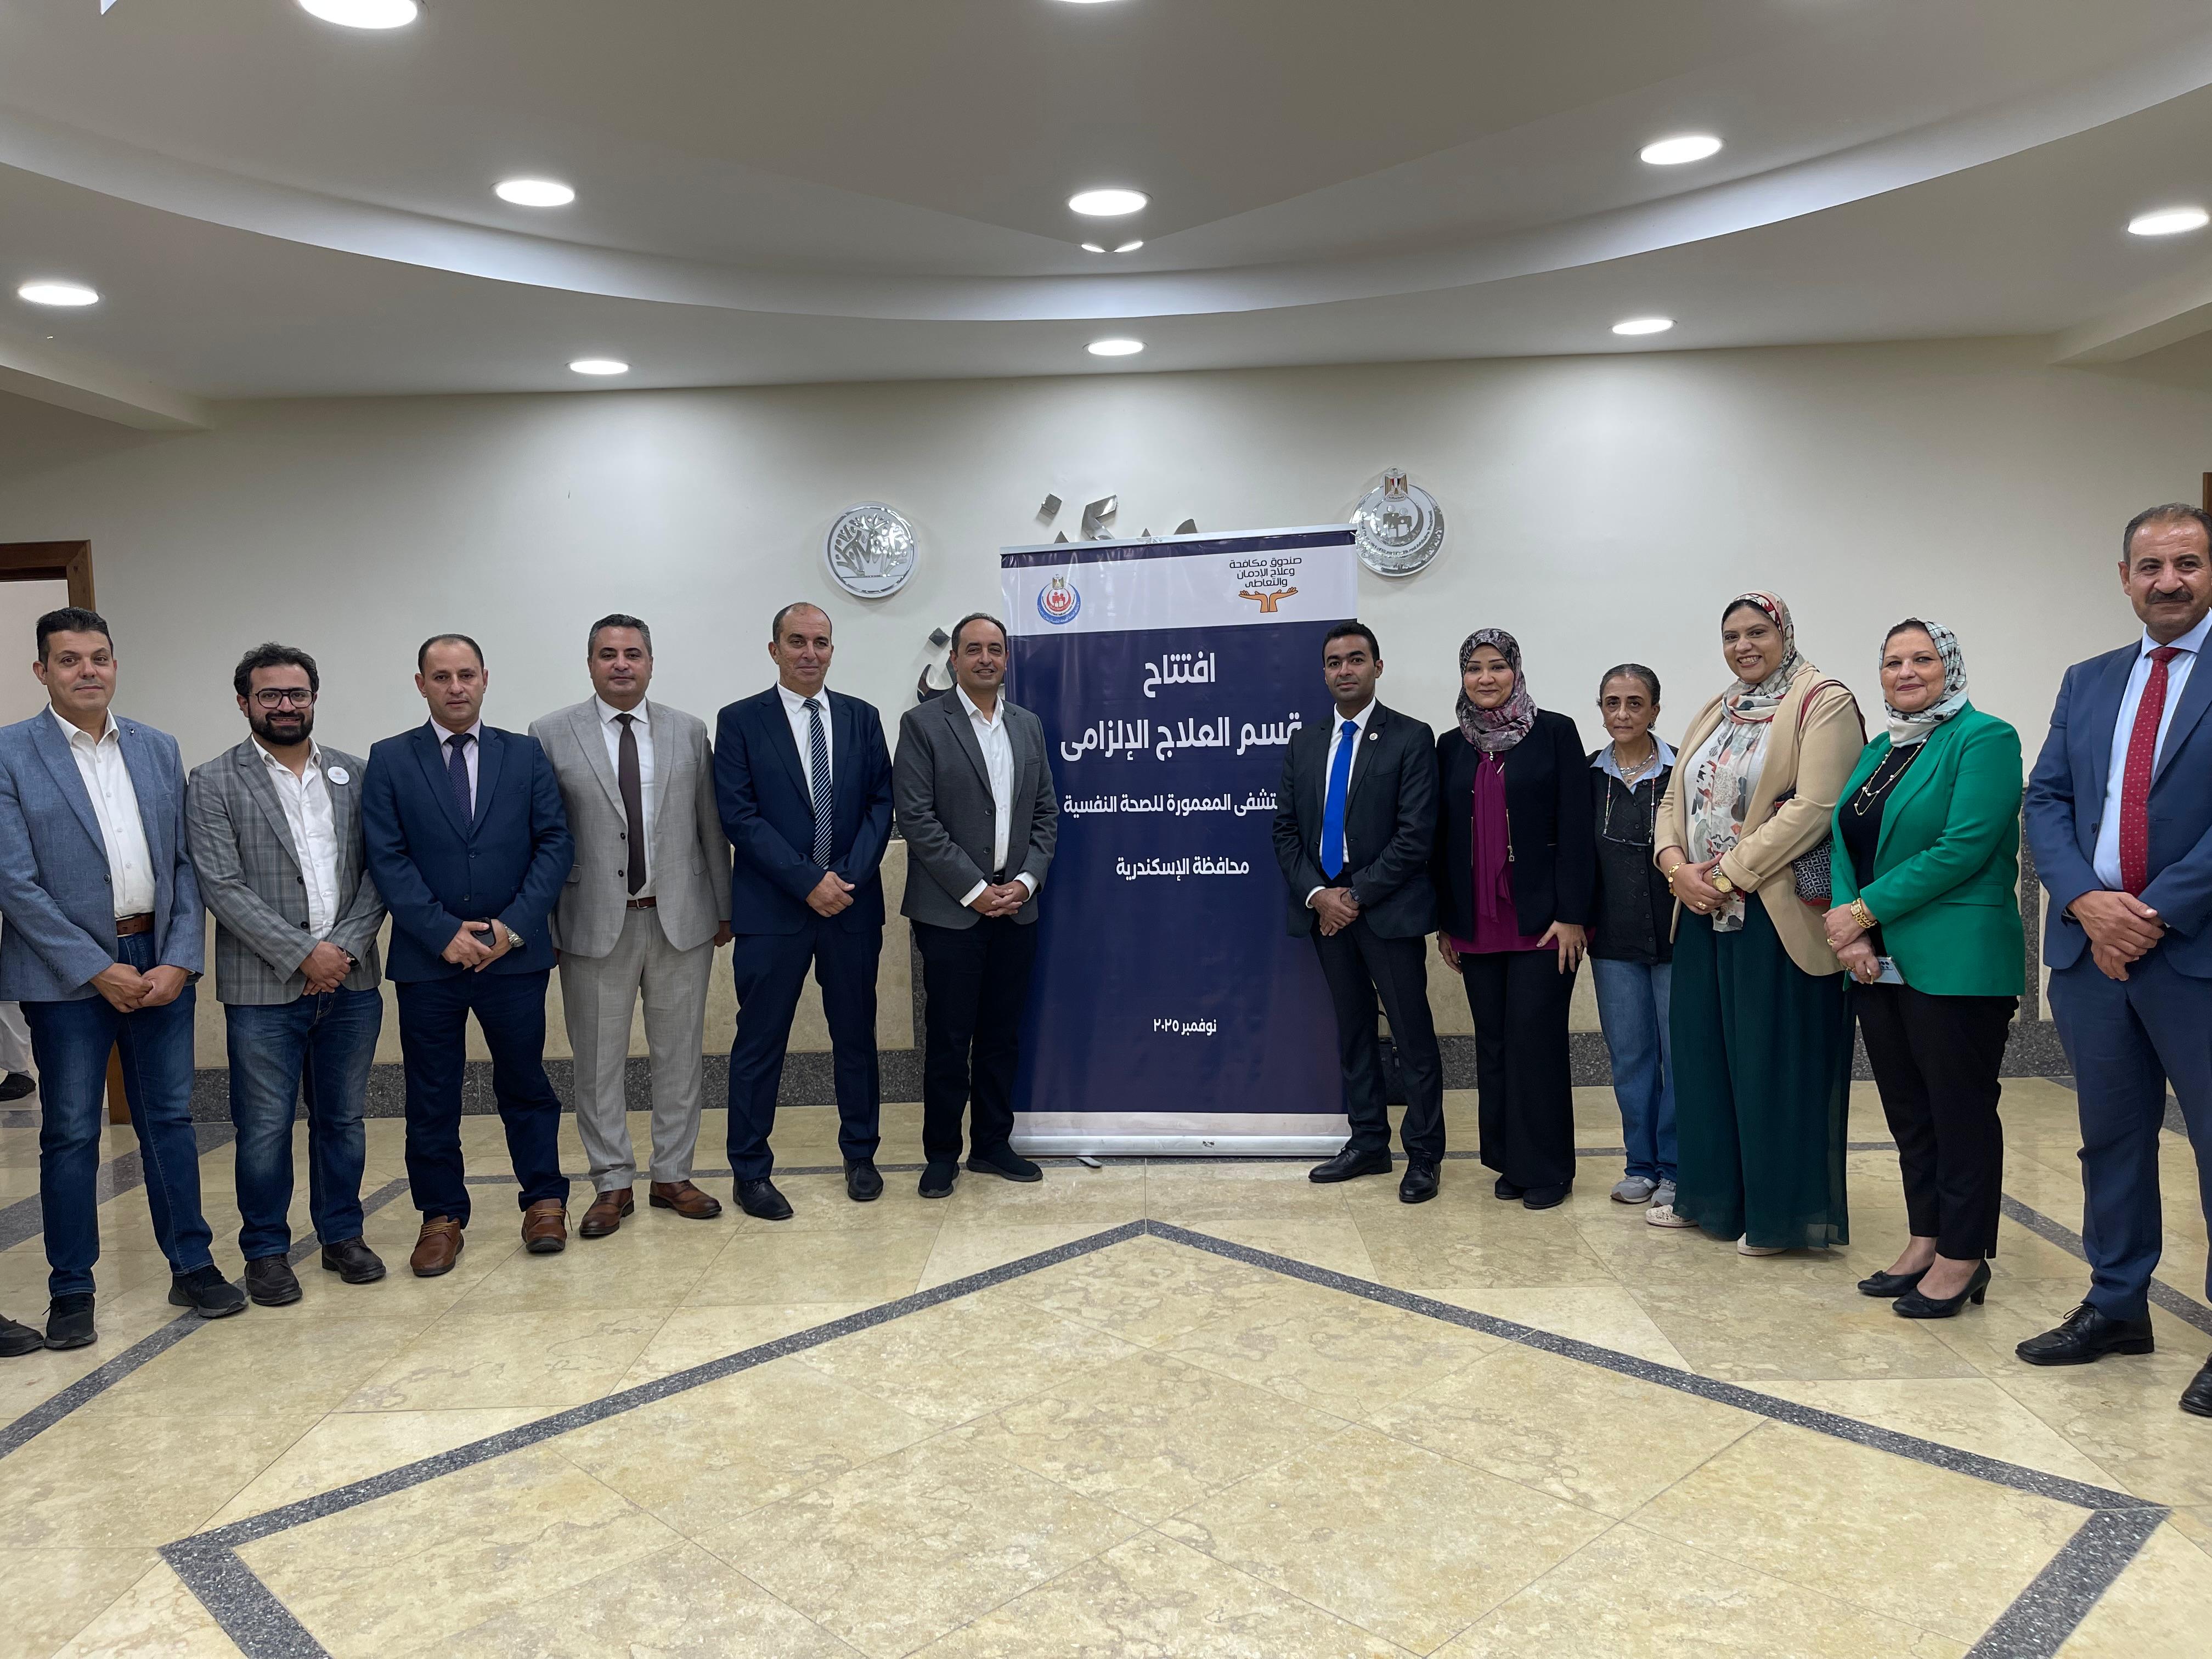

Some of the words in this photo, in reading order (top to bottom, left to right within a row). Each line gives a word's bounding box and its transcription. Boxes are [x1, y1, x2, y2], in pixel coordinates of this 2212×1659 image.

[1229, 558, 1267, 568] مكافحة
[1269, 556, 1302, 567] صندوق
[1237, 568, 1268, 579] الإدمان
[1270, 567, 1295, 578] وعلاج
[1245, 577, 1288, 588] والتعاطى
[1143, 651, 1216, 698] افتتاح
[1060, 719, 1149, 761] الإلزامى
[1155, 716, 1230, 761] العلاج
[1236, 712, 1302, 755] قسم
[1063, 794, 1117, 819] النفسية
[1120, 793, 1164, 812] للصحة
[1166, 793, 1231, 816] المعمورة
[1234, 788, 1278, 817] تشفى
[1116, 857, 1189, 882] الإسكندرية
[1193, 856, 1250, 874] محافظة
[1153, 1018, 1180, 1032] ٢٠٢٥
[1181, 1018, 1217, 1036] نوفمبر
